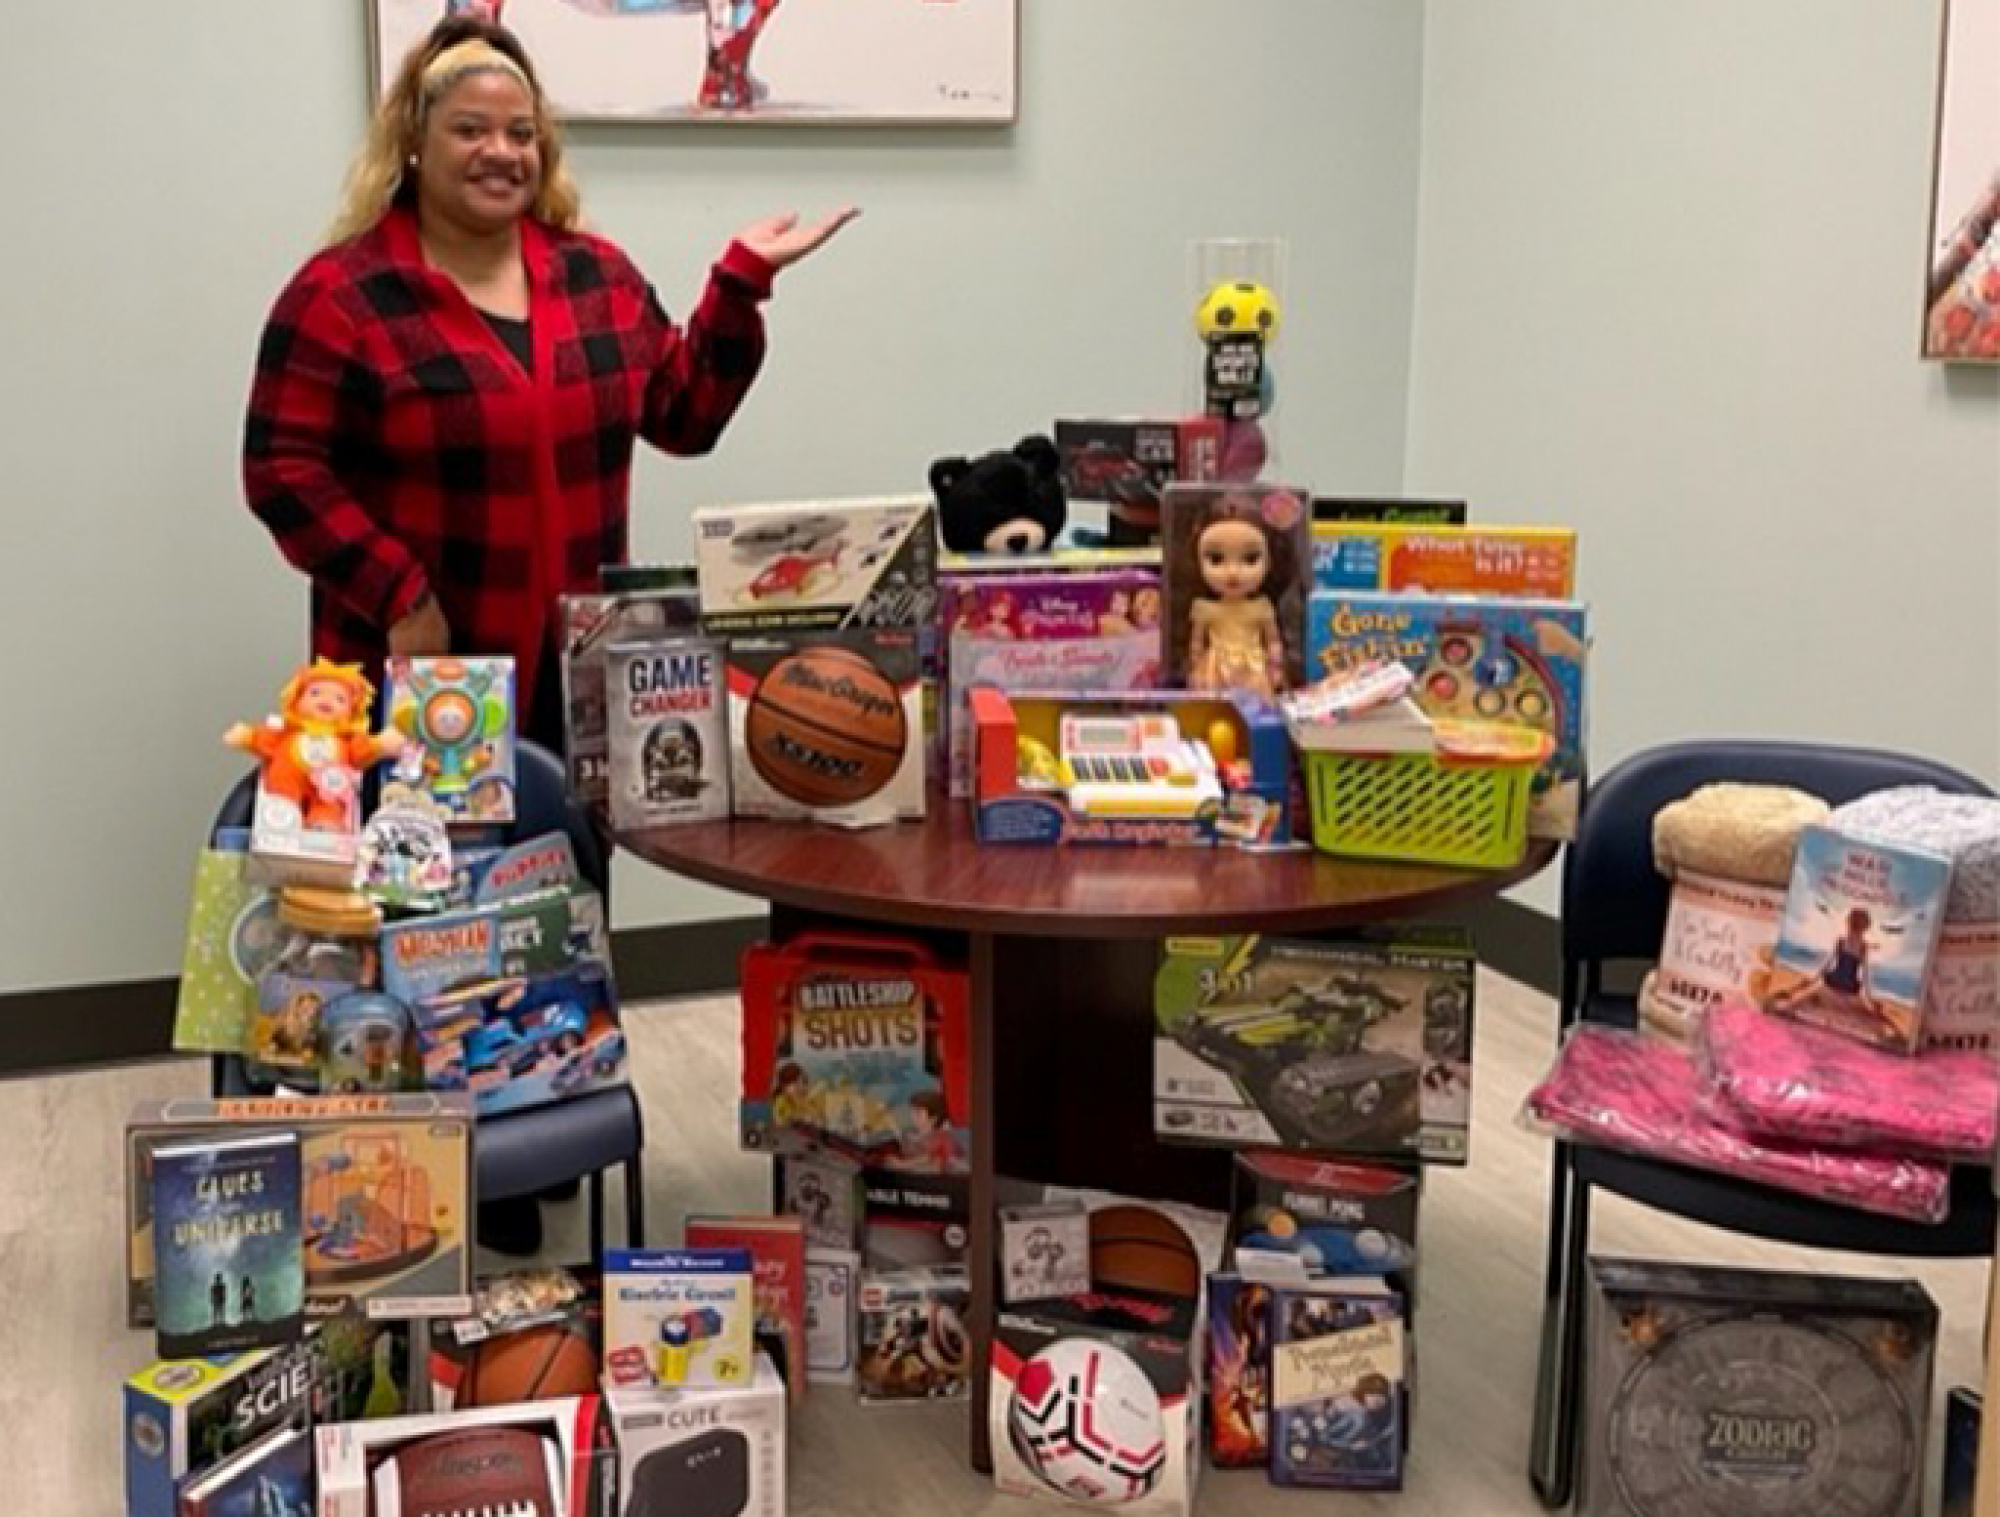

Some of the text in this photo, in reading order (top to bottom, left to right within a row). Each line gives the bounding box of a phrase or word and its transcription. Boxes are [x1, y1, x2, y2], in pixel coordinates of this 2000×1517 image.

[628, 656, 713, 694] GAME
[629, 689, 713, 718] CHANGER
[800, 980, 915, 1008] BATTLESHIP
[805, 1011, 918, 1050] SHOTS
[667, 1407, 723, 1429] CUTE
[1708, 1414, 1813, 1449] ZODIAC
